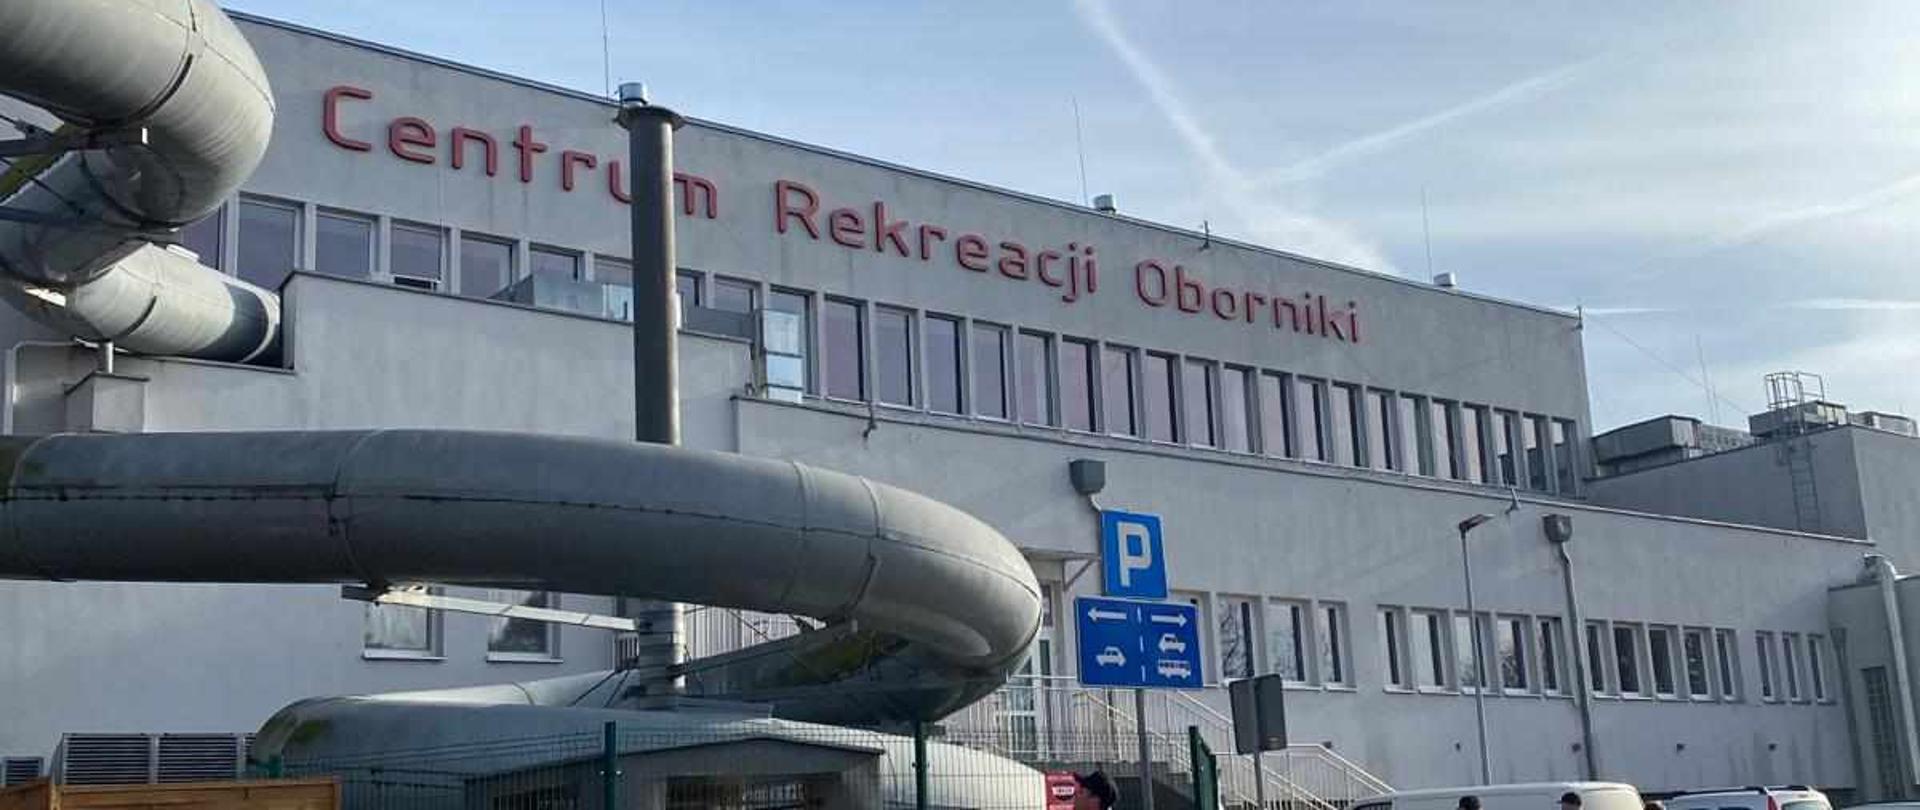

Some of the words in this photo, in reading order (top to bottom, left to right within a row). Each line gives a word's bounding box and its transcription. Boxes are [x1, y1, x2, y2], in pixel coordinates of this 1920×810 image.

[774, 179, 1098, 304] Rekreacji
[1136, 258, 1360, 343] Oborniki
[1116, 521, 1152, 588] P
